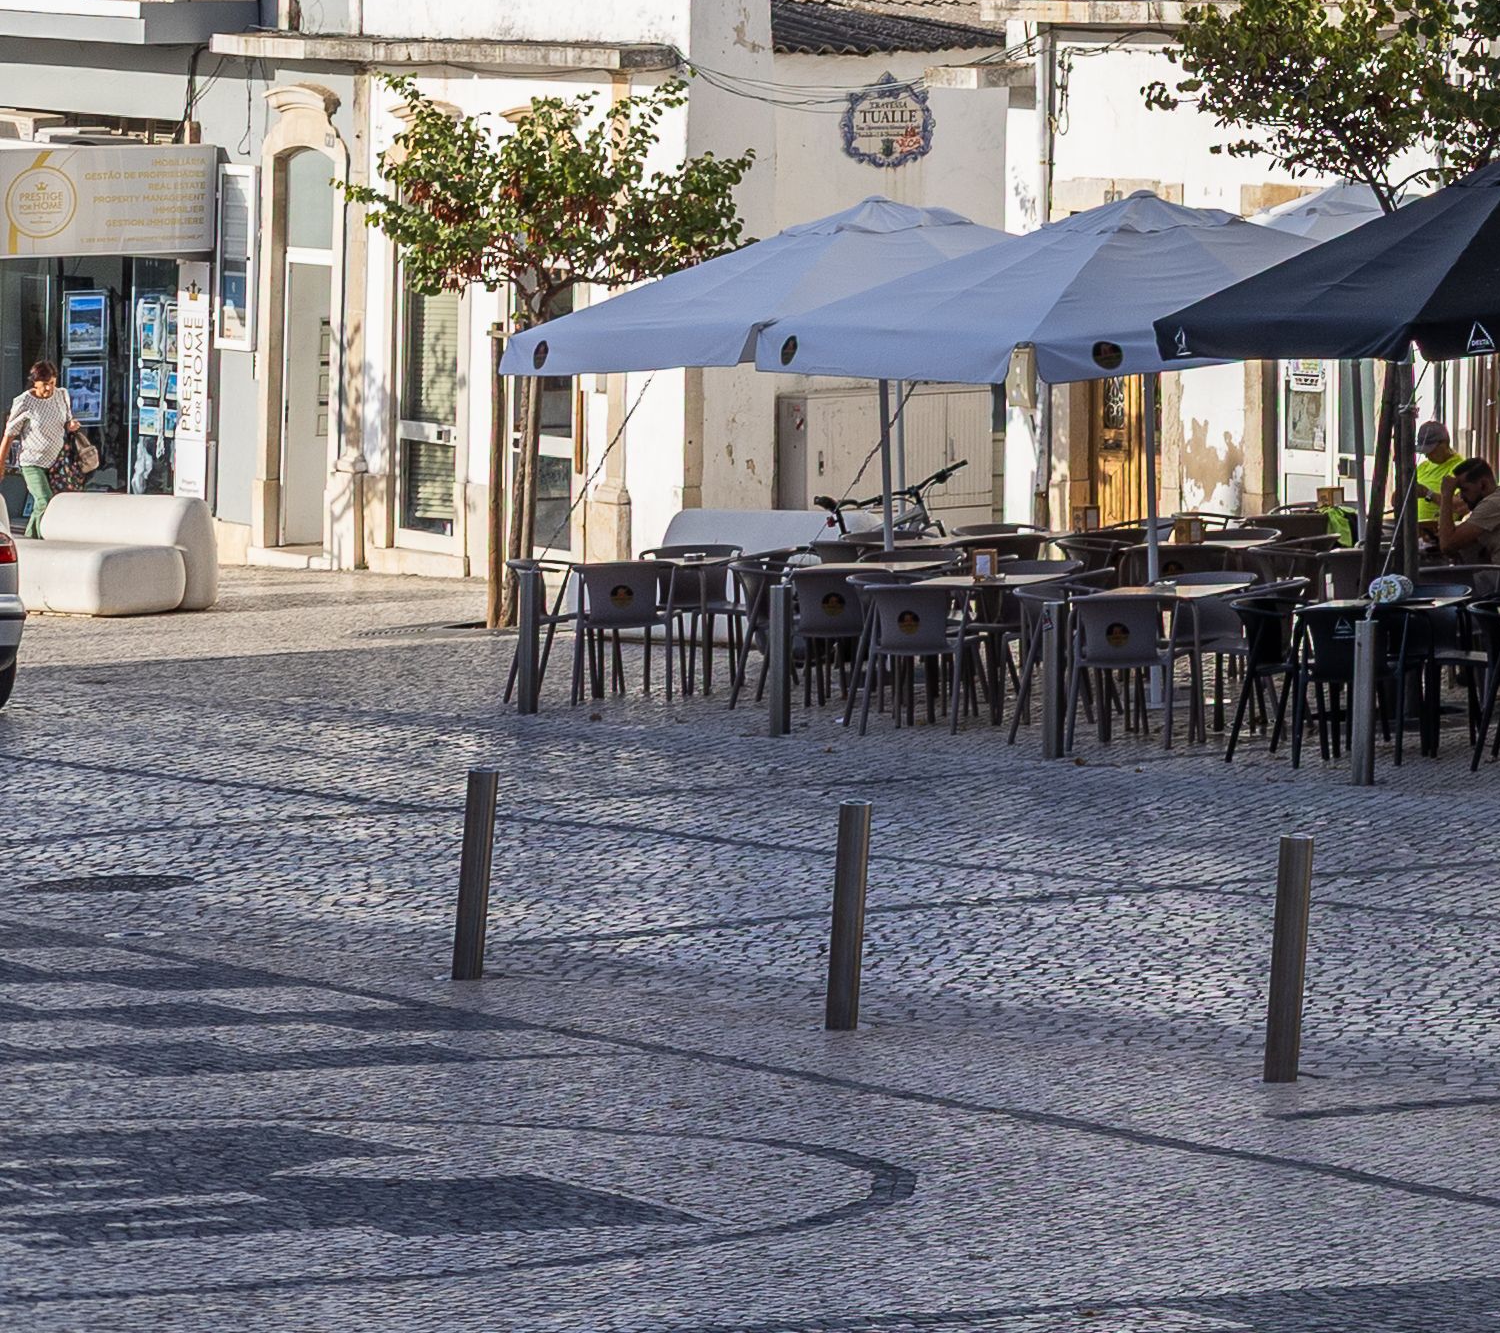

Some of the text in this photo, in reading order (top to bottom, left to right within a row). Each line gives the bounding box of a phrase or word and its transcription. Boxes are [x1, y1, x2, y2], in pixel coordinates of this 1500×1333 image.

[860, 110, 917, 123] TUALLE
[84, 171, 121, 181] GESTÃO
[124, 171, 136, 180] DE
[173, 182, 206, 190] ESTATE
[19, 191, 64, 201] PRESTIGE
[93, 193, 206, 204] PROPERTY MANAGEMENT
[32, 202, 63, 211] HOME
[182, 317, 194, 431] PRESTIGE
[193, 317, 204, 433] FOR HOME
